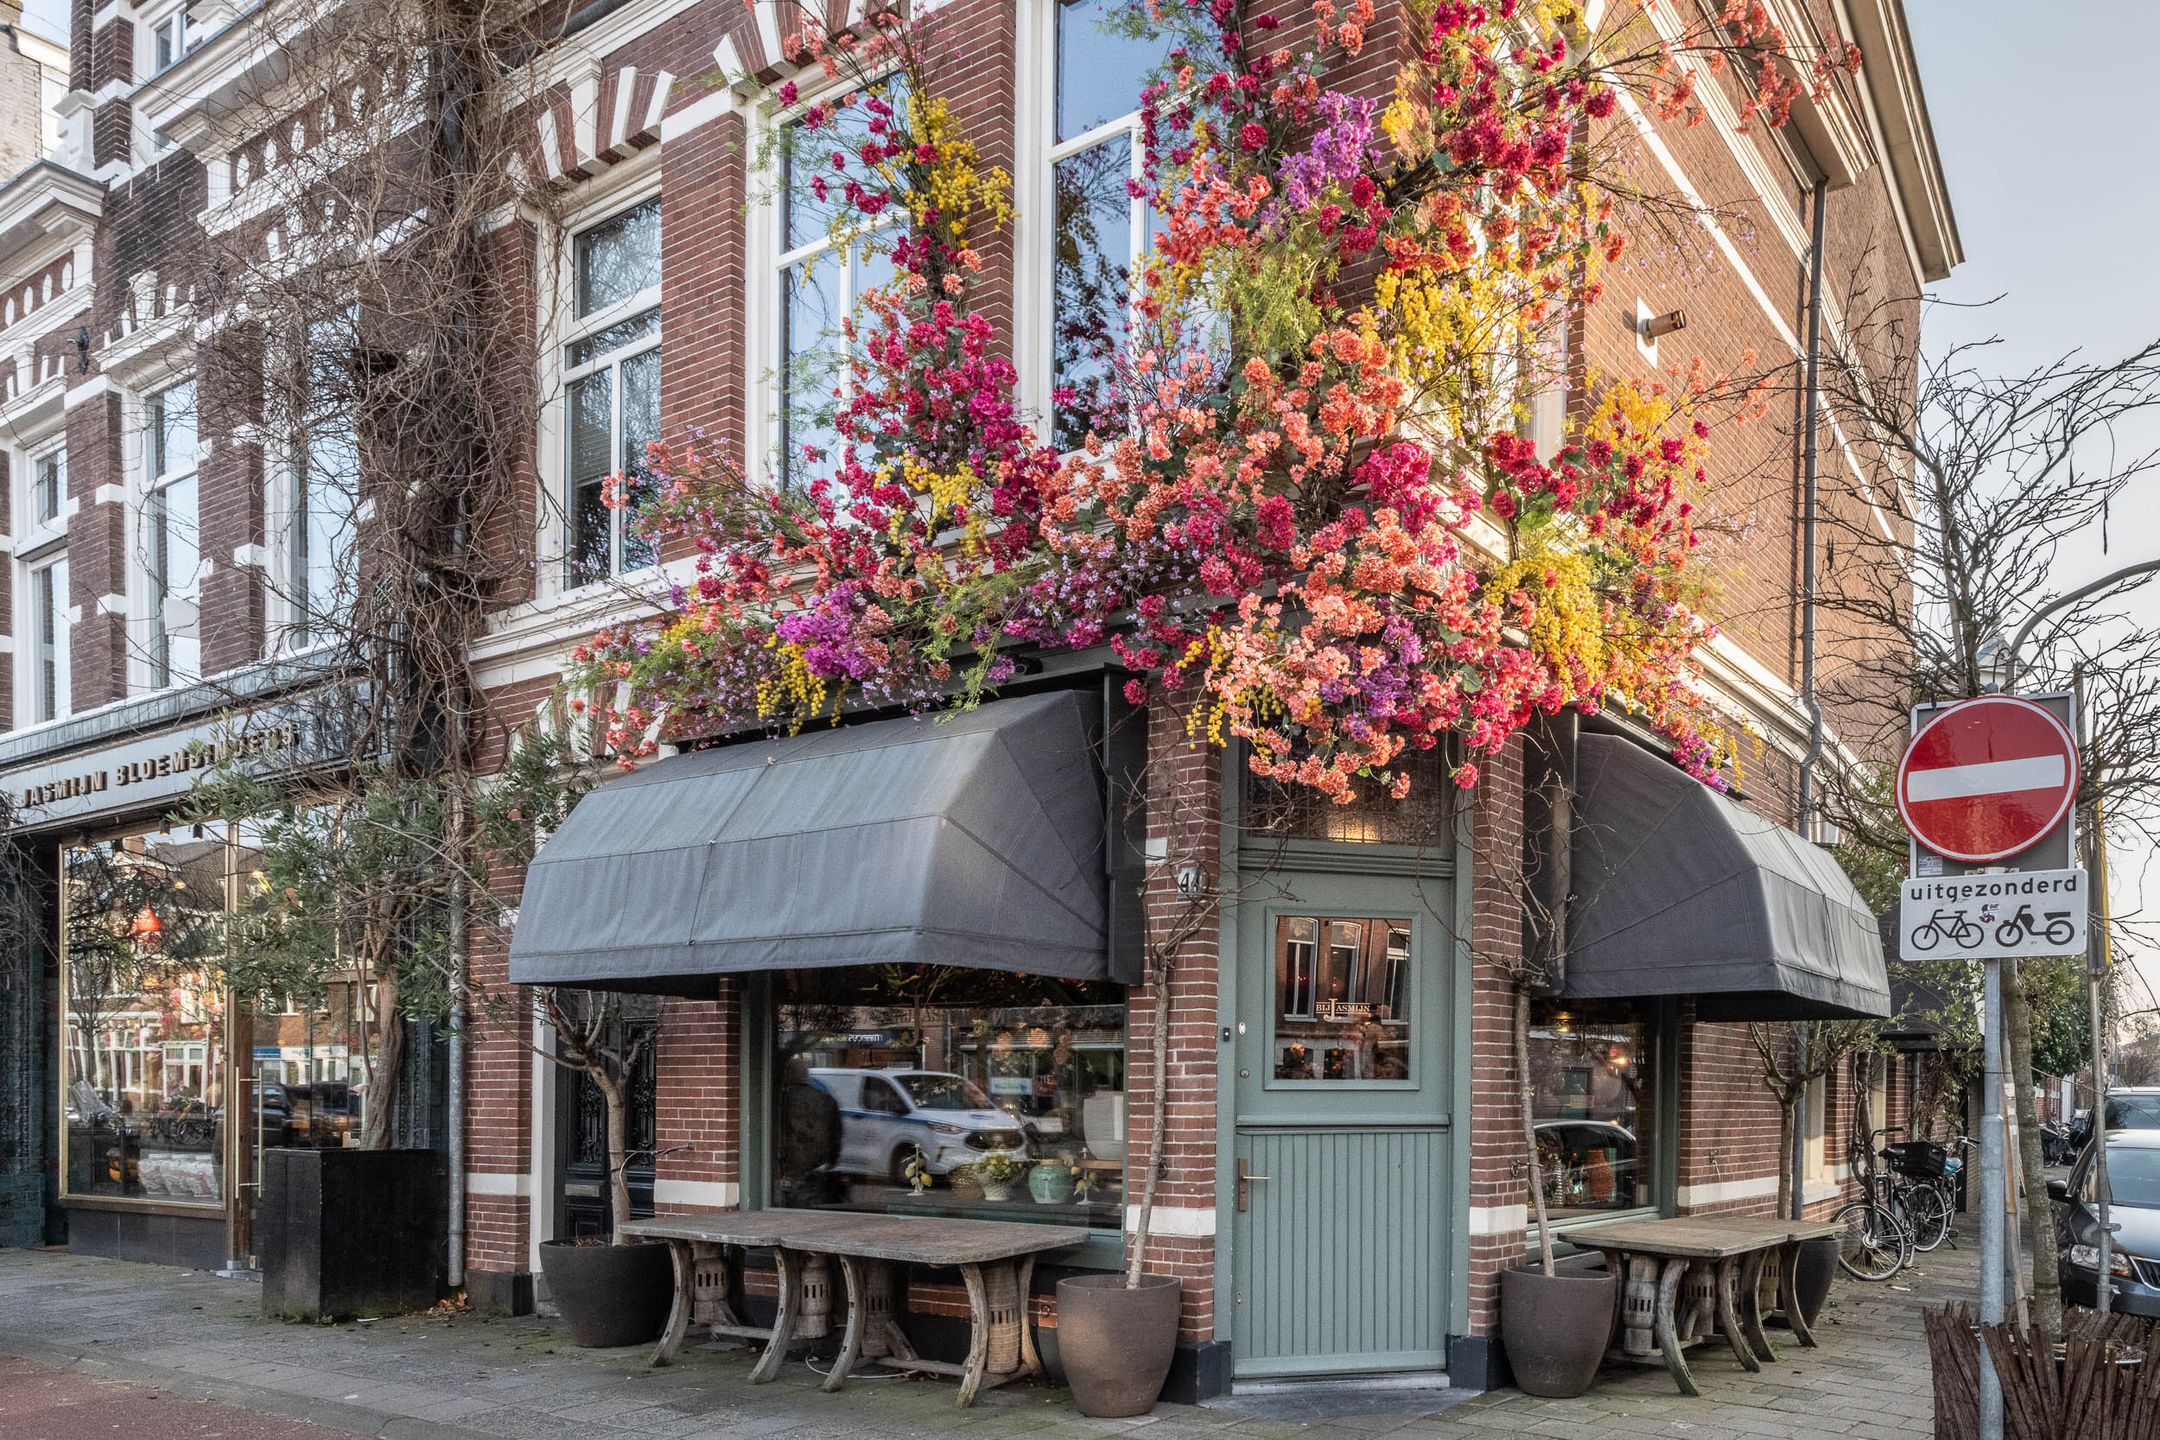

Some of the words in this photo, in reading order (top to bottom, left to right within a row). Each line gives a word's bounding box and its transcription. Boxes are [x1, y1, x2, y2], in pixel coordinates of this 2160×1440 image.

[21, 771, 107, 808] JASMIJN
[1911, 874, 2077, 903] uitgezonderd
[1323, 998, 1370, 1021] JASMIJN
